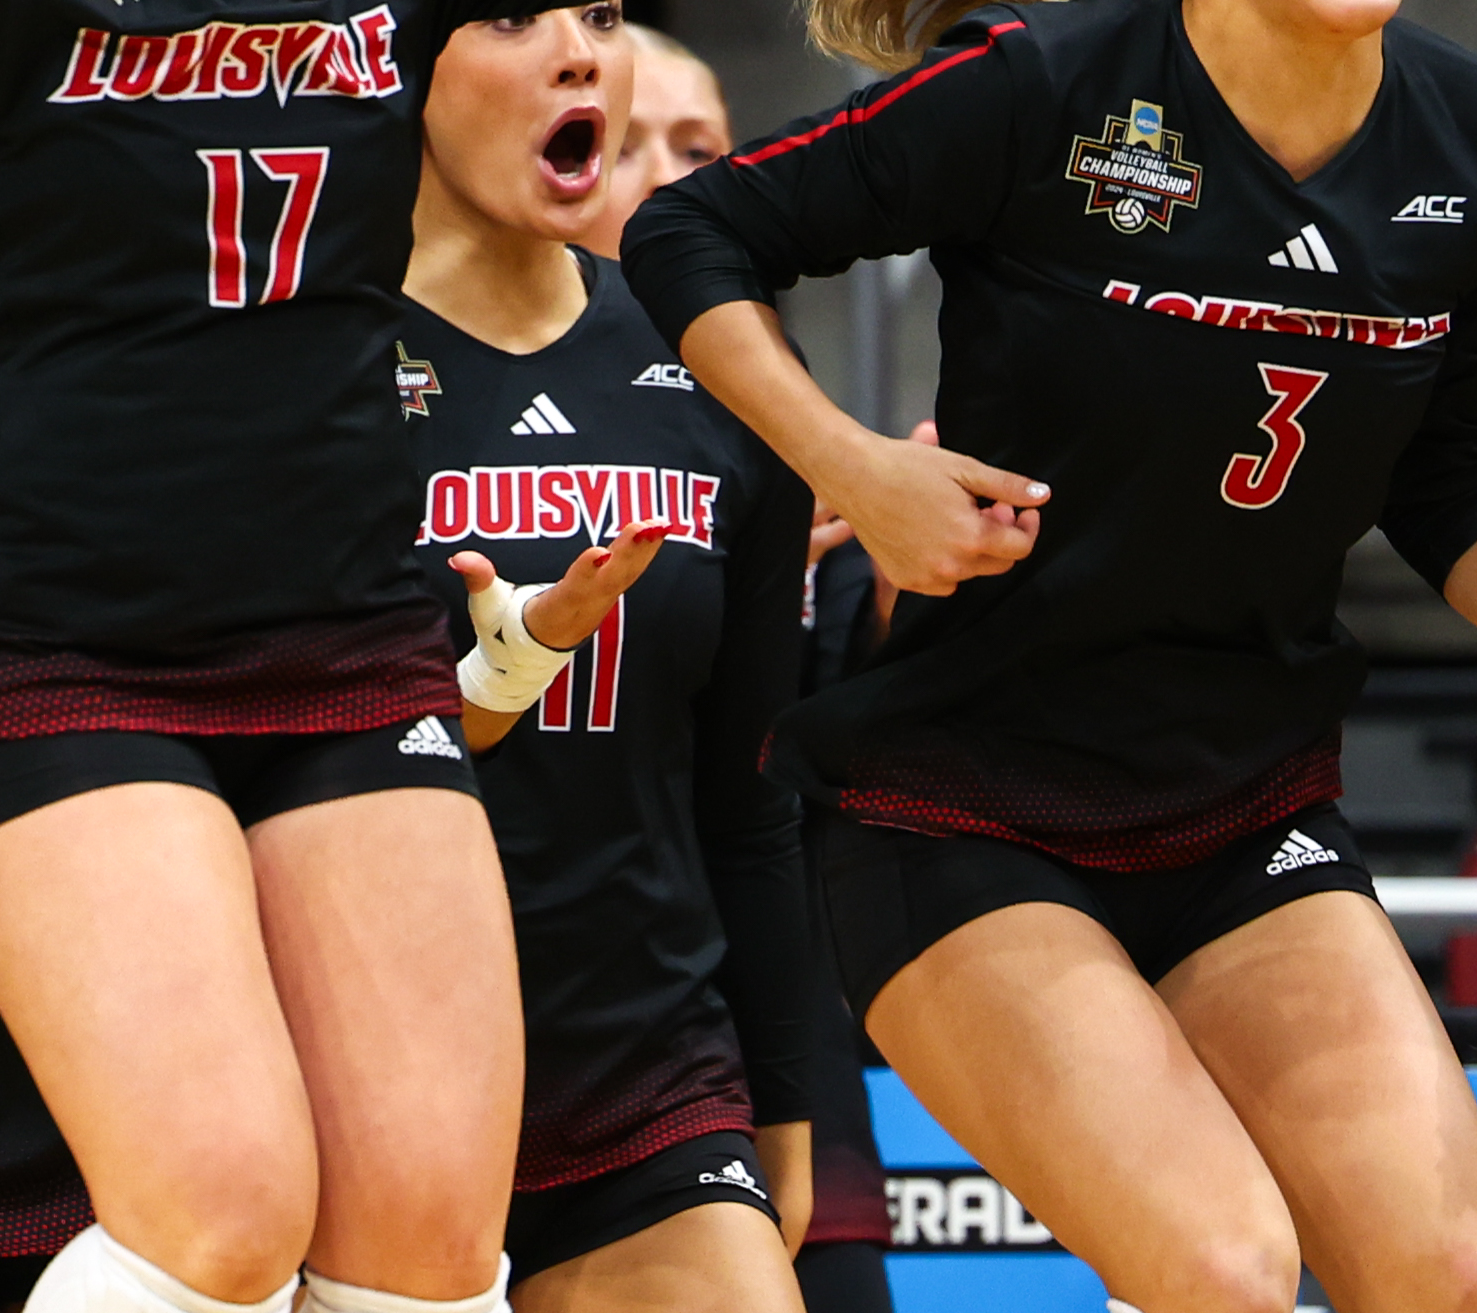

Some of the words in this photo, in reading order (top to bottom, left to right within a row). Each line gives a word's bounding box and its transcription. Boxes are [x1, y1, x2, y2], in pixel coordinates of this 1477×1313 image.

[1079, 156, 1192, 195] CHAMPIONSHIP
[1111, 149, 1167, 173] VOLLEYBALL
[1391, 196, 1467, 223] ACC
[197, 147, 330, 307] 17
[631, 363, 695, 390] ACC
[1221, 363, 1328, 509] 3
[1265, 847, 1339, 876] adidas
